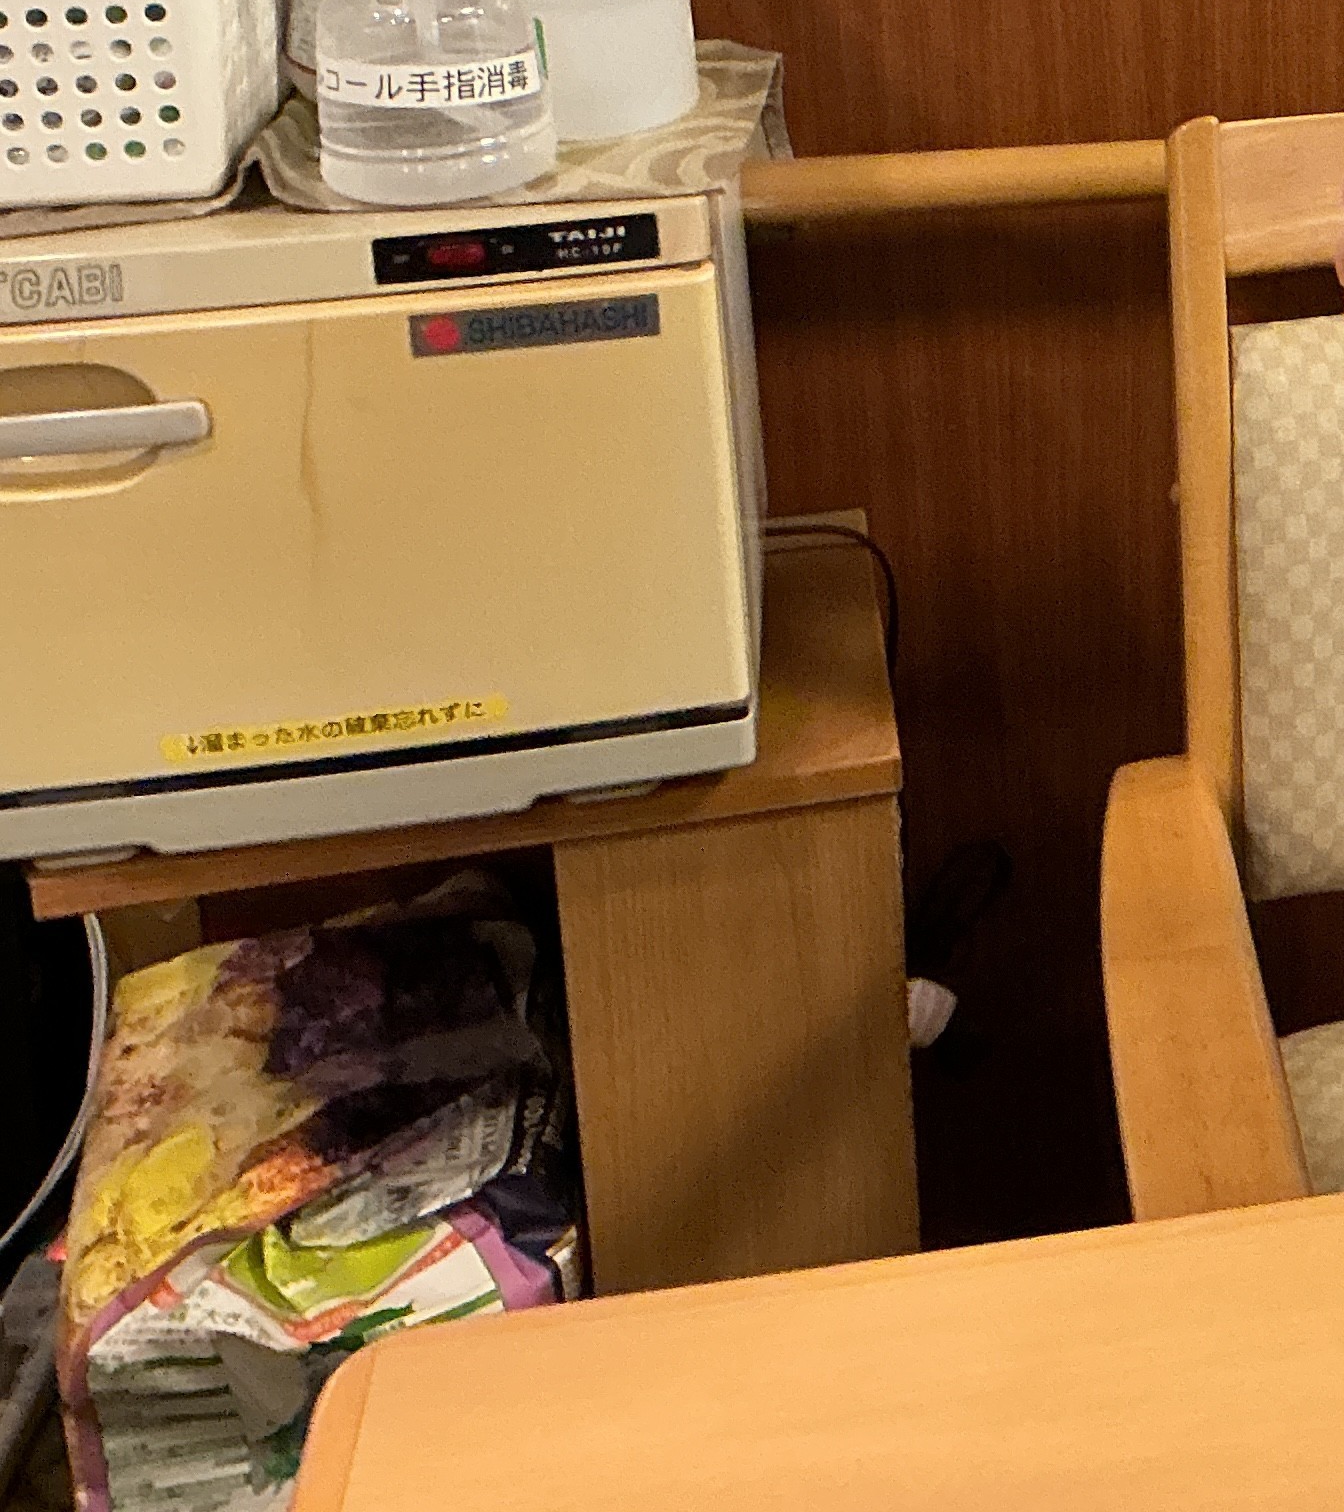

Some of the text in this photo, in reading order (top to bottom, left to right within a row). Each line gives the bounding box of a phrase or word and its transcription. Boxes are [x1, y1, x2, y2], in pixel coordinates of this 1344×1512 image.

[319, 61, 529, 102] コール手指消毒
[548, 225, 626, 243] TAIJI
